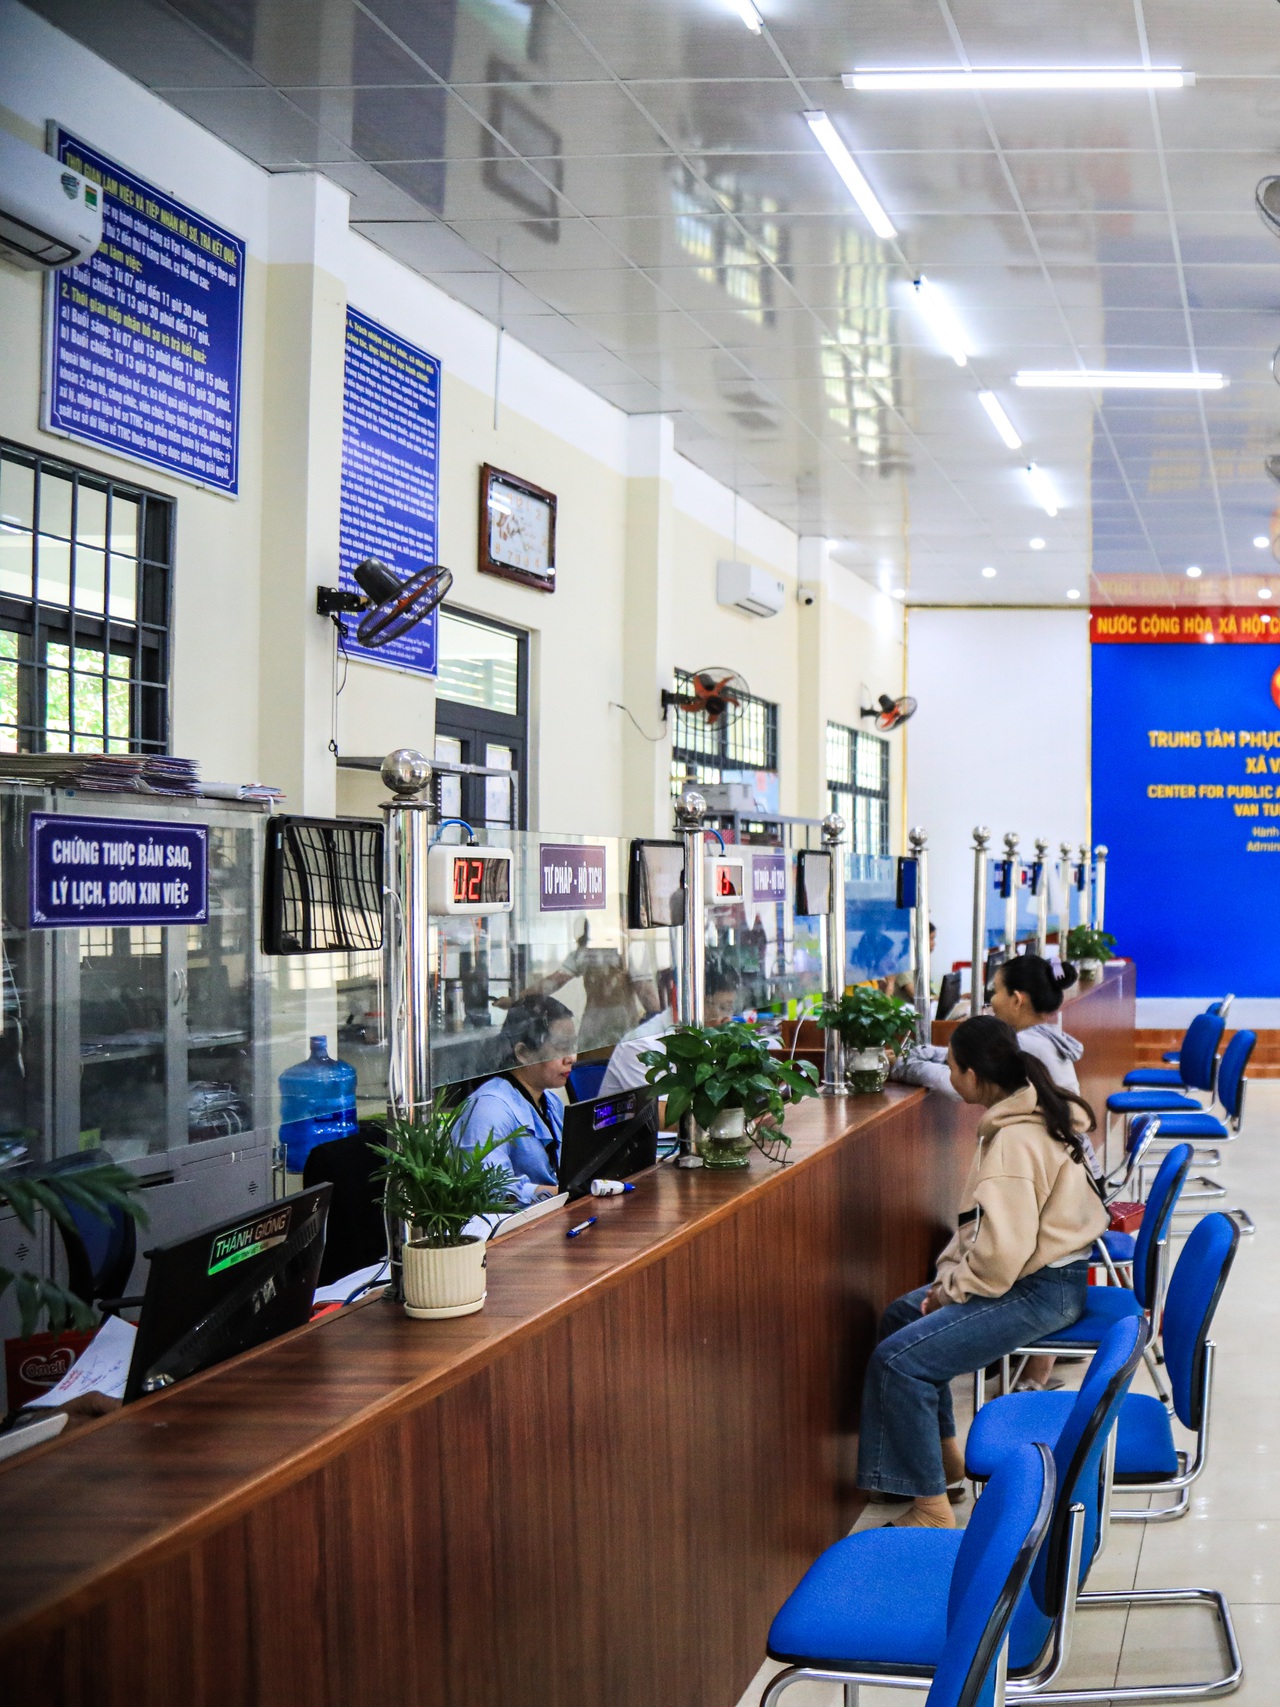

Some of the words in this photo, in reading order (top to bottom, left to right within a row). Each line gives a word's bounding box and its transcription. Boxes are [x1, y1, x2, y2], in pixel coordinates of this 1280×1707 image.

[1097, 615, 1137, 634] NƯỚC
[1140, 614, 1180, 637] CỘNG
[1184, 614, 1213, 634] HÒA
[1219, 614, 1237, 634] XÃ
[1148, 730, 1201, 748] TRUNG
[1205, 728, 1236, 748] TÂM
[1245, 754, 1268, 774] XÃ
[1147, 785, 1196, 798] CENTER
[1198, 785, 1224, 798] FOR
[1227, 785, 1274, 798] PUBLIC
[1234, 803, 1259, 816] VAN
[52, 835, 99, 864] CHỨNG
[102, 840, 135, 870] THỰC
[138, 837, 164, 867] BẢN
[166, 845, 192, 870] SAO,
[52, 876, 69, 905] LÝ
[71, 880, 106, 910] LỊCH,
[109, 879, 136, 905] ĐƠN
[139, 882, 161, 905] XIN
[163, 878, 189, 909] VIỆC
[453, 860, 484, 900] 02
[544, 863, 554, 894] TƯ
[554, 860, 573, 894] PHÁP
[578, 861, 588, 900] HỘ
[588, 866, 603, 900] TỊCH
[215, 1228, 254, 1258] THÁNH
[254, 1213, 287, 1241] GIÓNG
